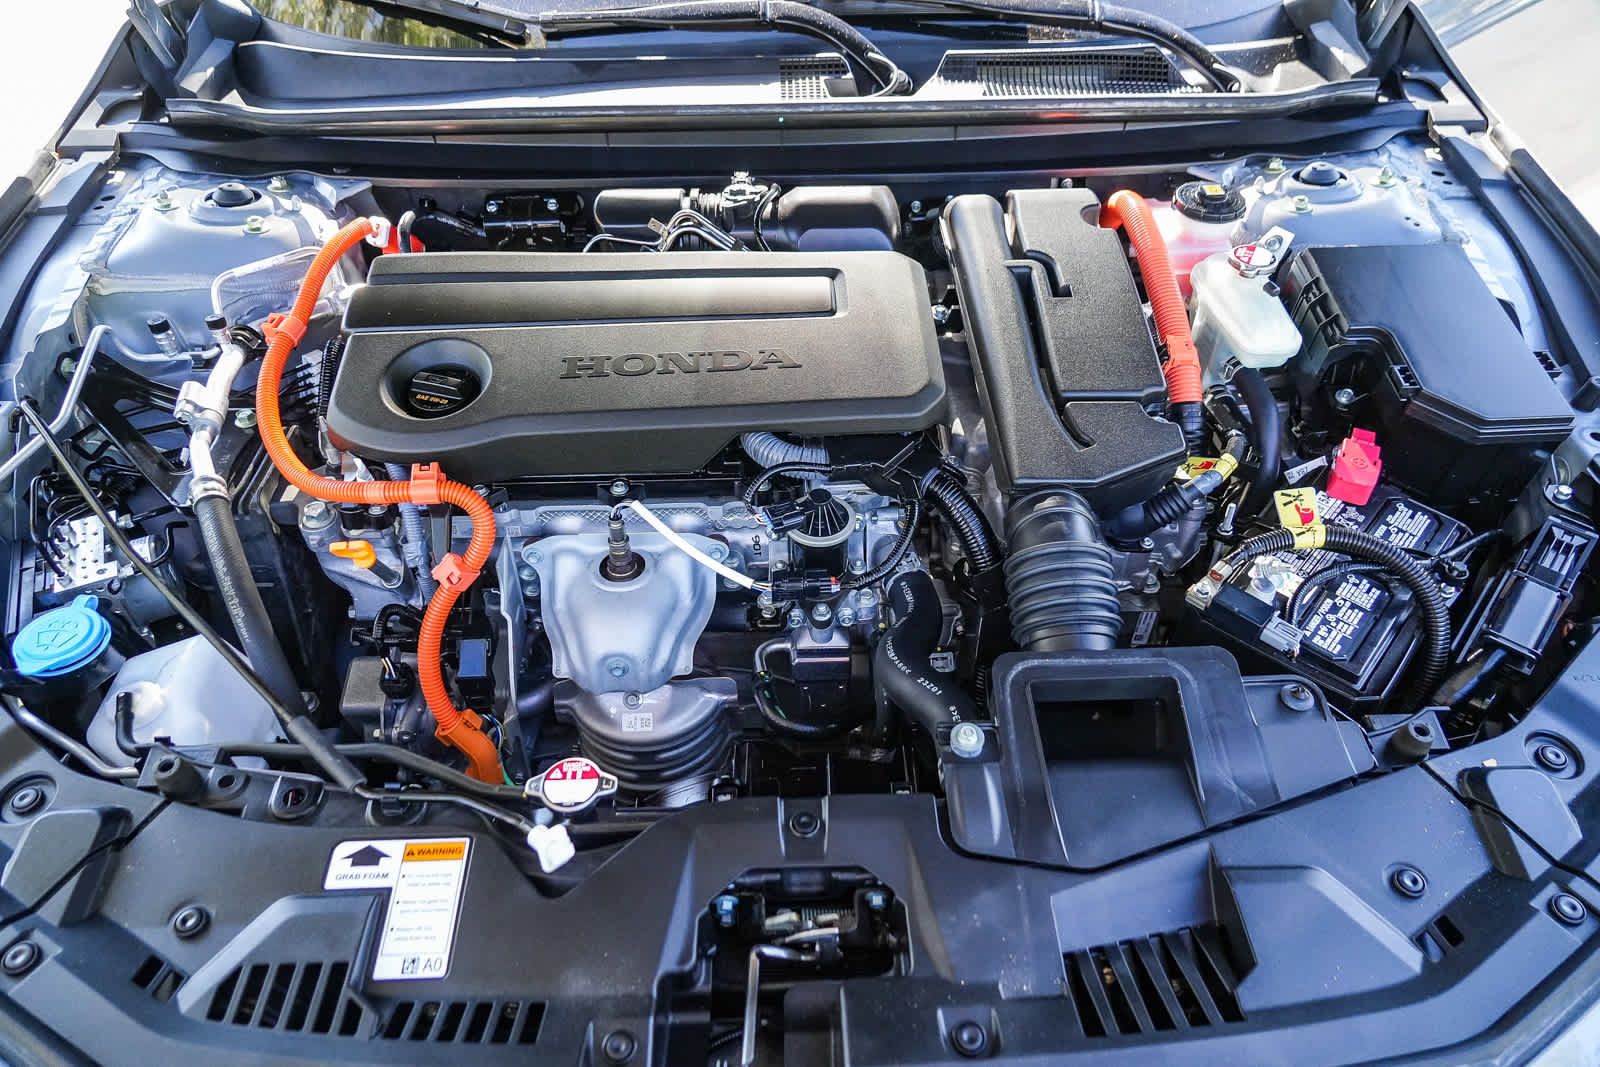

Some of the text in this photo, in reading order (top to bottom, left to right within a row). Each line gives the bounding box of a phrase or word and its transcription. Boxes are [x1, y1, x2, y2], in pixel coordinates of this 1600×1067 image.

[559, 348, 803, 380] HONDA
[417, 847, 462, 856] WARNING
[362, 871, 390, 880] FOAM
